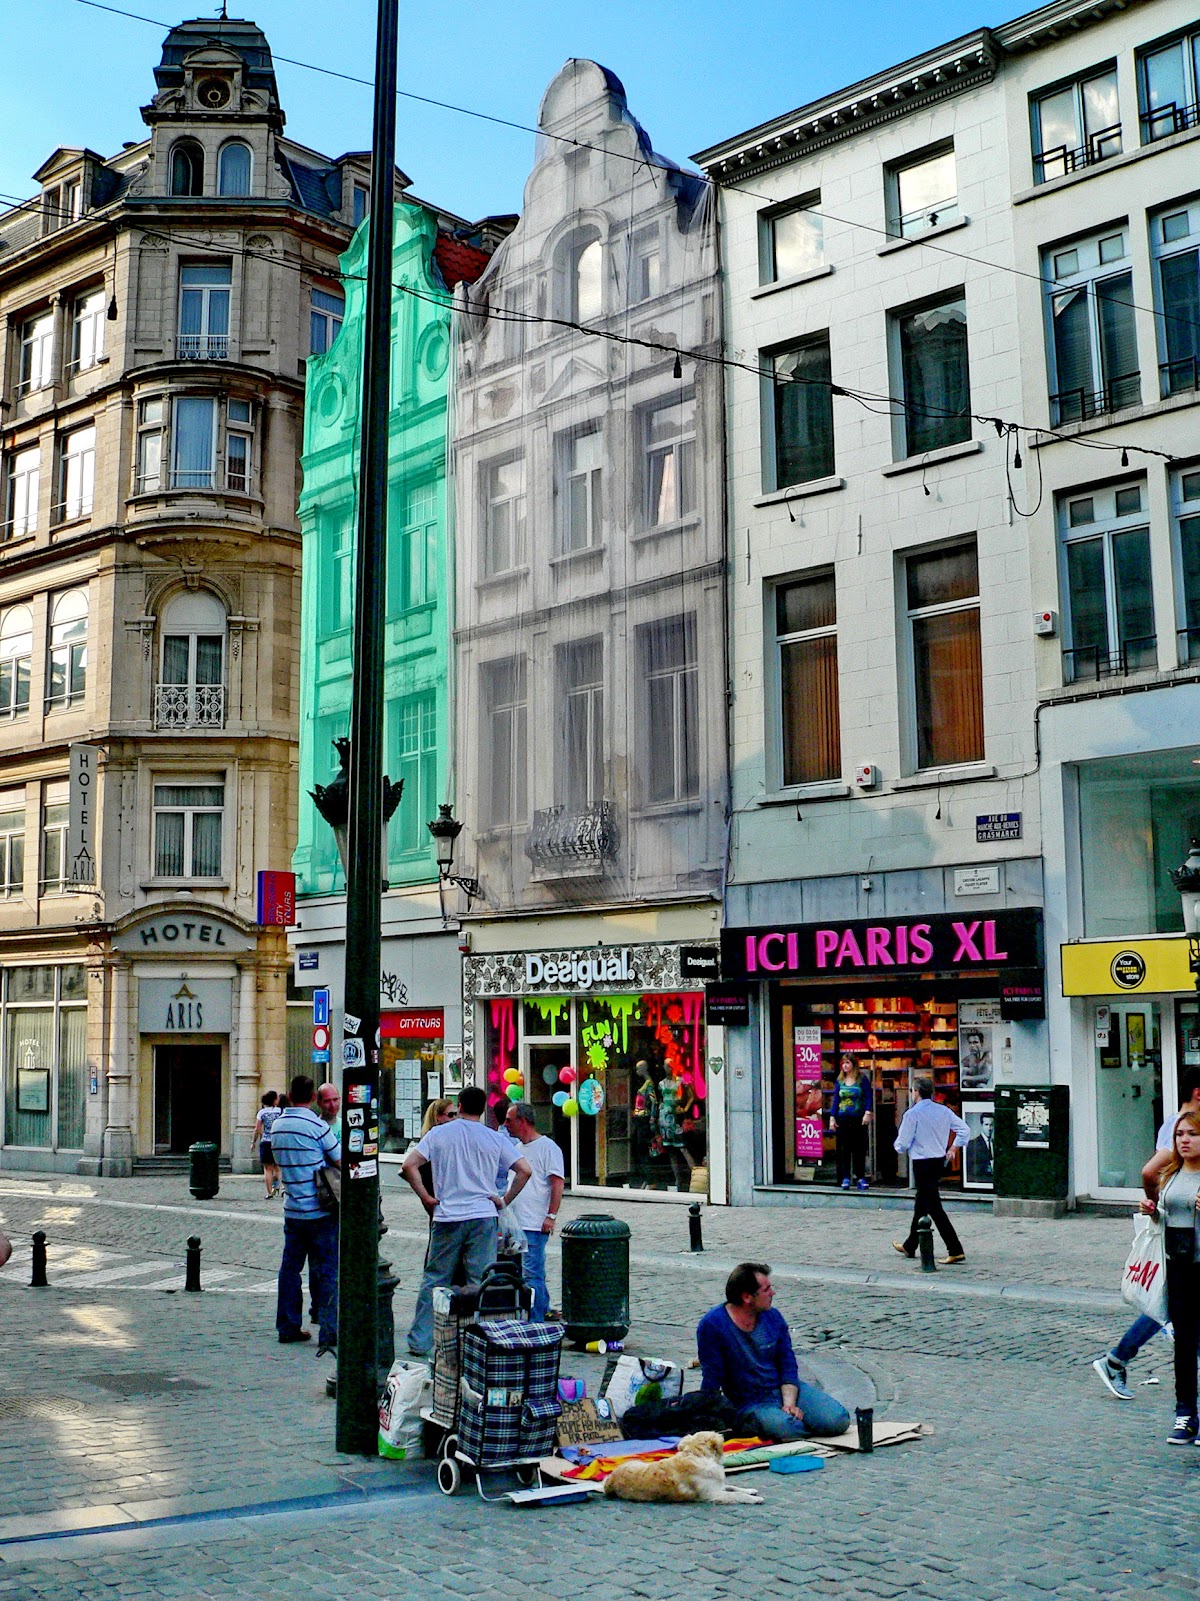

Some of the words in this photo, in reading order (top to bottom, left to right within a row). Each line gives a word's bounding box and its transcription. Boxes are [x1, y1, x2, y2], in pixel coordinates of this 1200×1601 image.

[78, 753, 90, 844] HOTEL
[977, 829, 1018, 839] GRASMARKT
[72, 860, 96, 880] ARIS
[275, 902, 284, 924] CITY
[283, 890, 292, 923] TOURS
[140, 923, 226, 946] HOTEL
[745, 932, 799, 972] ICI
[815, 924, 934, 968] PARIS
[952, 919, 1008, 962] XL
[165, 1002, 203, 1029] ARIS
[400, 1018, 441, 1028] CITYTOURS
[20, 1039, 40, 1047] HOTEL
[582, 1019, 611, 1047] FUN
[1126, 1257, 1160, 1292] H&M
